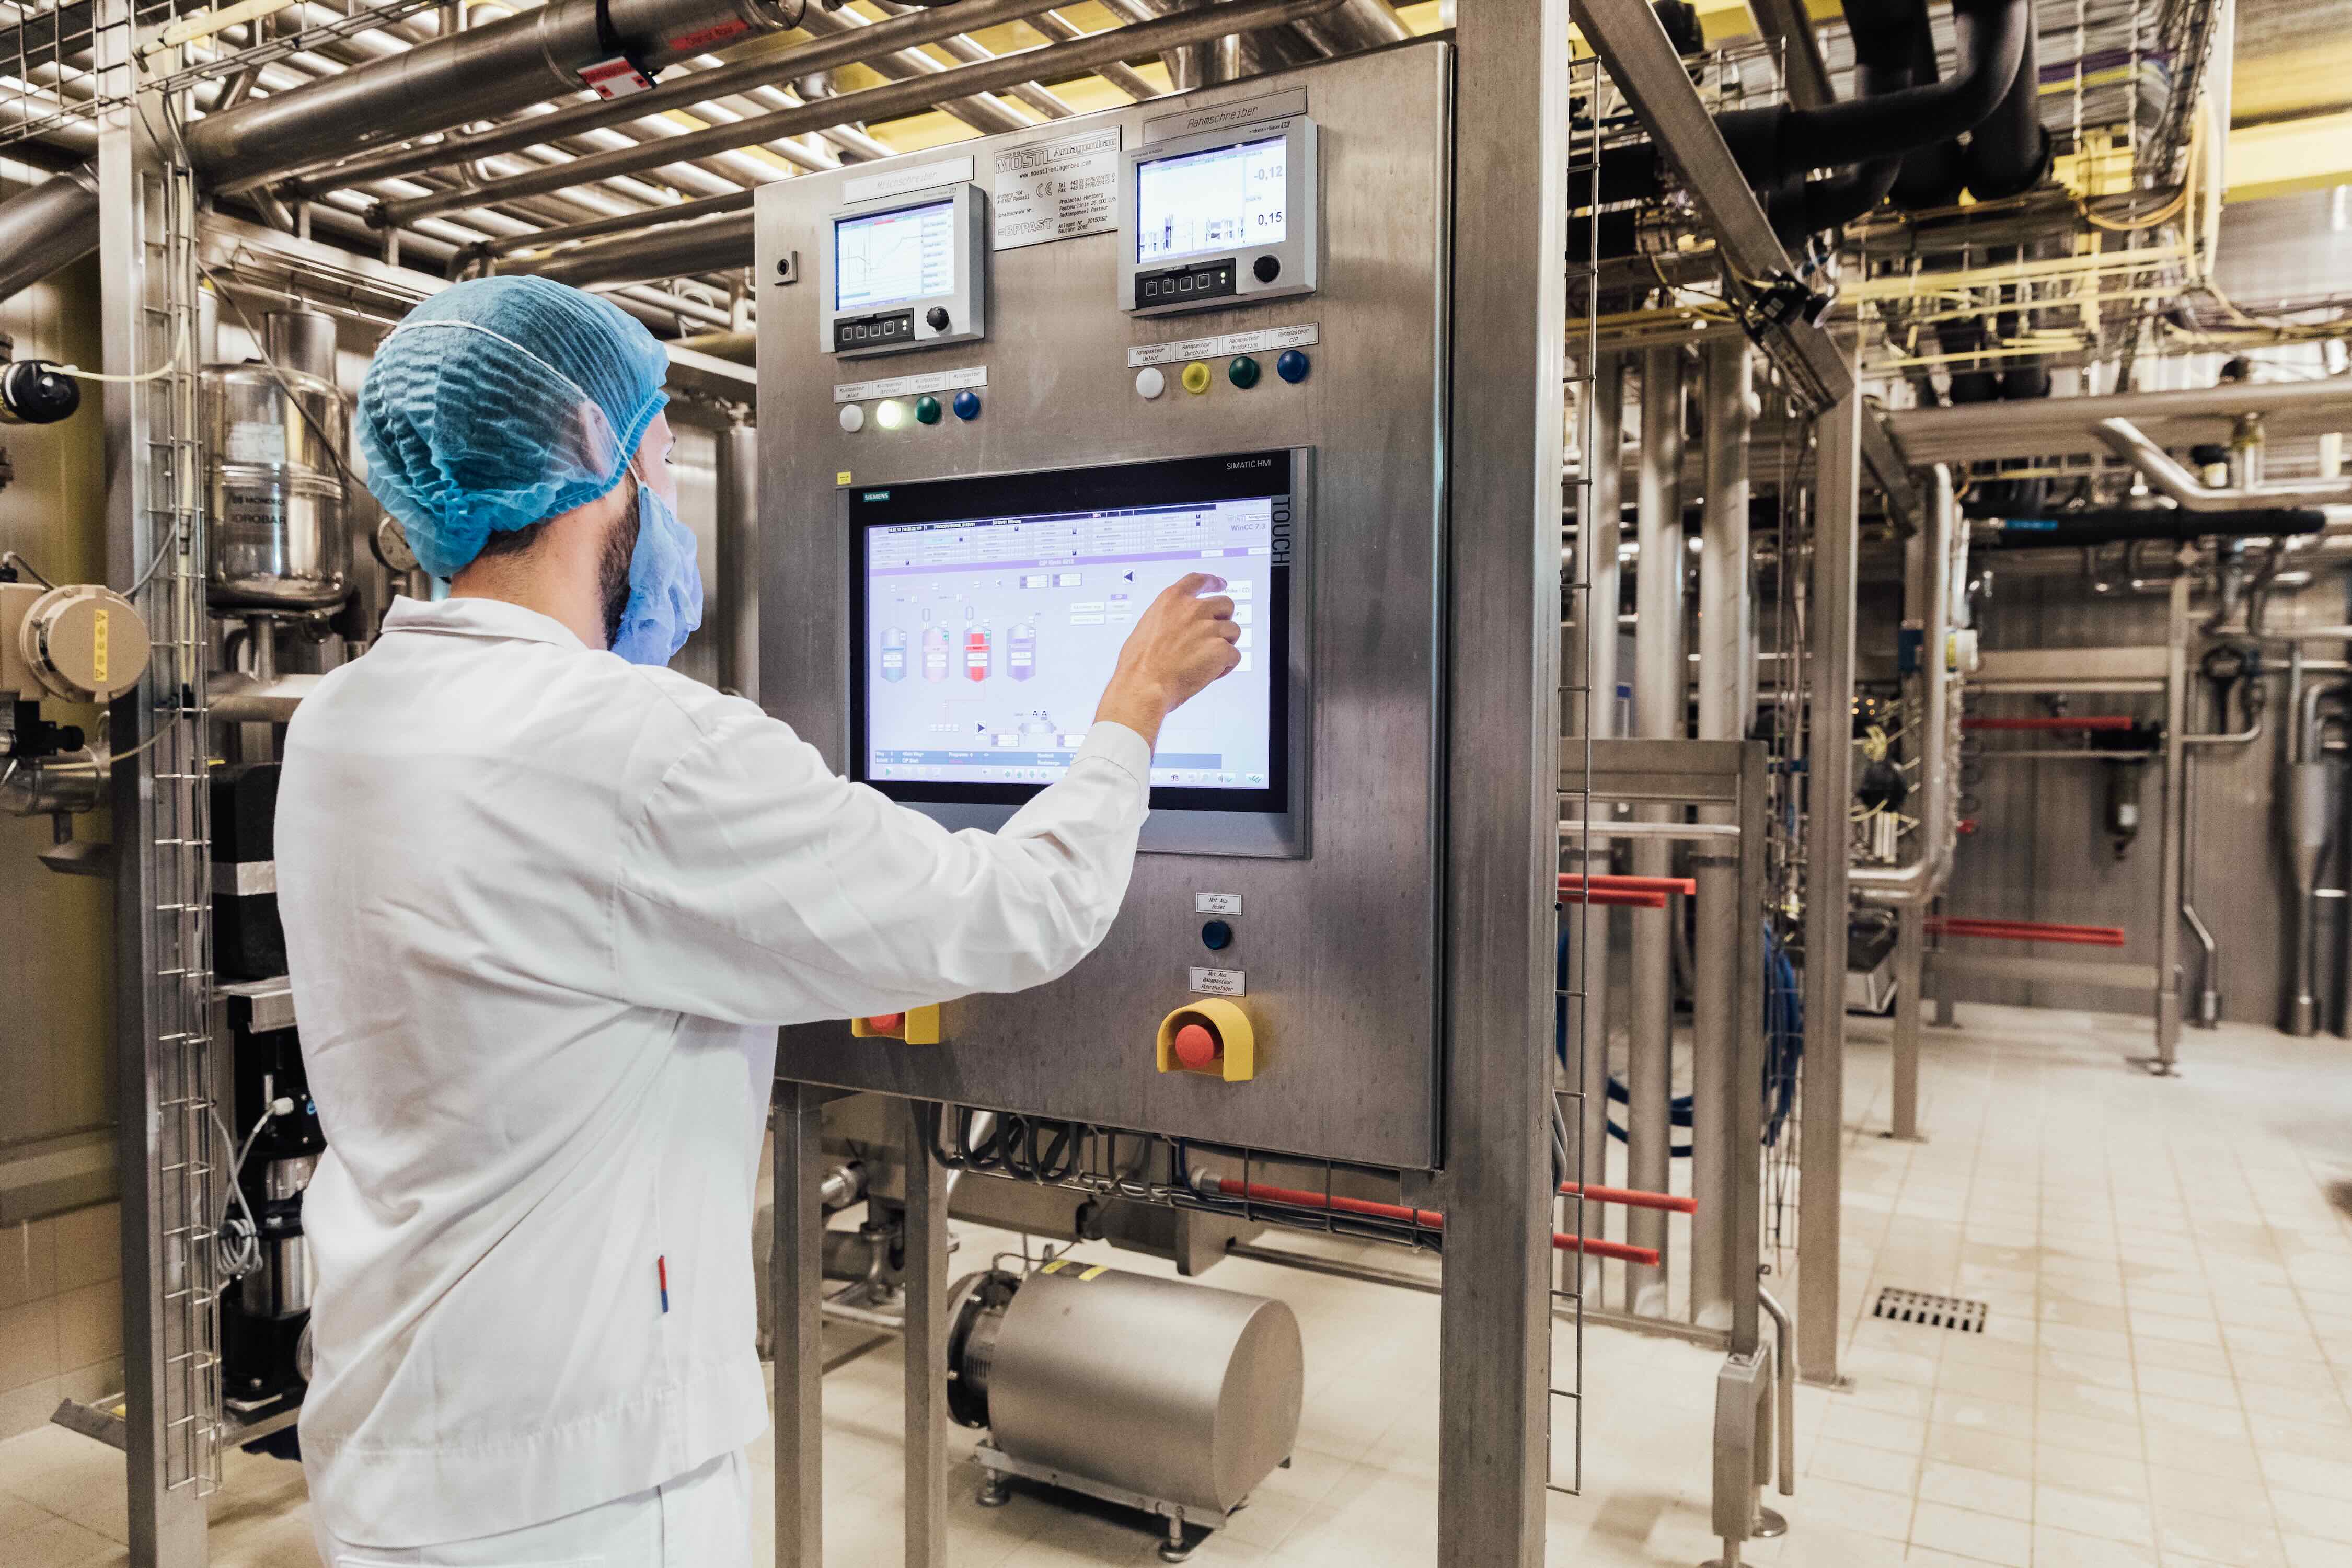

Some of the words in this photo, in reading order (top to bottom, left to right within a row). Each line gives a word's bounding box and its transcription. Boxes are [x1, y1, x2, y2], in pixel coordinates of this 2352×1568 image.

[1187, 106, 1258, 129] Rahmschreiber
[1054, 138, 1117, 157] Anlagenbau
[996, 150, 1053, 174] MÖSTL
[1020, 160, 1092, 178] www.moestl-anlagenbau.com
[1254, 166, 1283, 181] -0,12
[1059, 203, 1089, 212] Pasteurlinie
[1059, 209, 1089, 218] Bedienpaneel
[1258, 211, 1282, 226] 0,15
[1277, 328, 1309, 337] Rahmpasteur
[1229, 335, 1260, 344] Rahmpasteur
[1182, 341, 1212, 350] Rahmpasteur
[1231, 342, 1258, 351] Produktion
[1136, 348, 1165, 356] Rahmpasteur
[1226, 459, 1256, 470] SIMATIC
[1258, 459, 1272, 468] HMI
[1272, 497, 1290, 564] TOUCH
